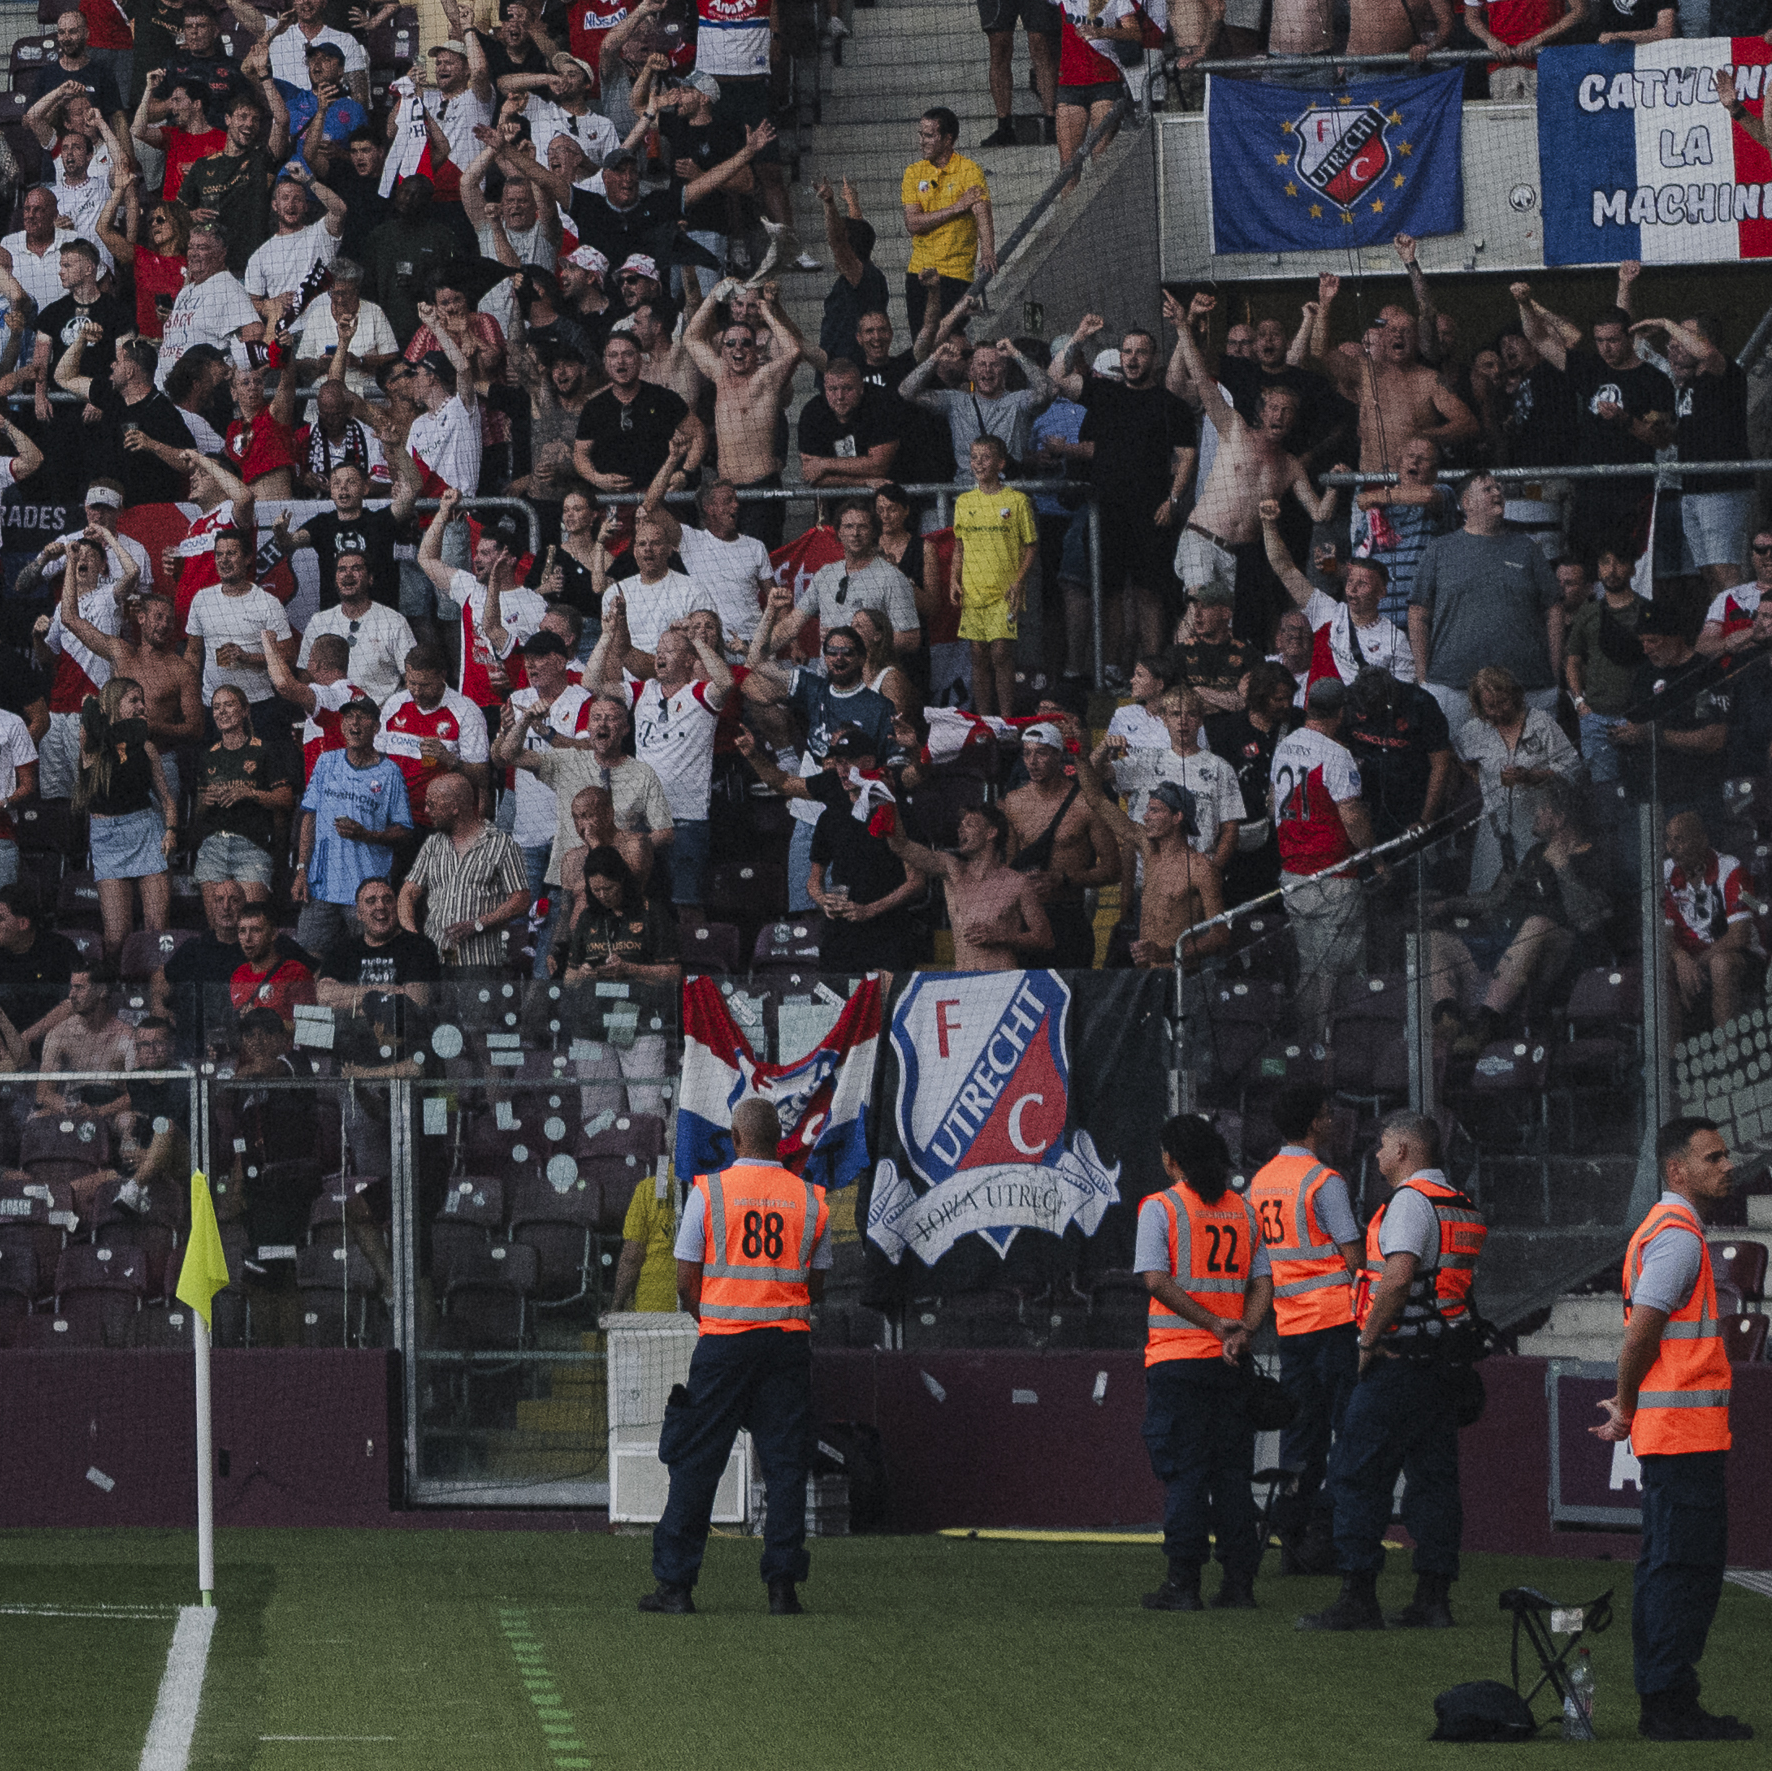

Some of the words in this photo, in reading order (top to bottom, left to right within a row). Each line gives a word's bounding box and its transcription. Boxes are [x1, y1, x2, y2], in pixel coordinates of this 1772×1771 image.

[584, 7, 628, 30] NISSAN
[1309, 113, 1380, 189] UTRECHT
[1316, 118, 1331, 142] F
[1659, 126, 1714, 168] LA
[1349, 157, 1370, 182] C
[1277, 764, 1311, 822] 21
[936, 999, 962, 1059] F
[930, 978, 1049, 1169] UTRECHT
[1009, 1093, 1047, 1156] C
[742, 1211, 784, 1260] 88
[1205, 1224, 1239, 1274] 22
